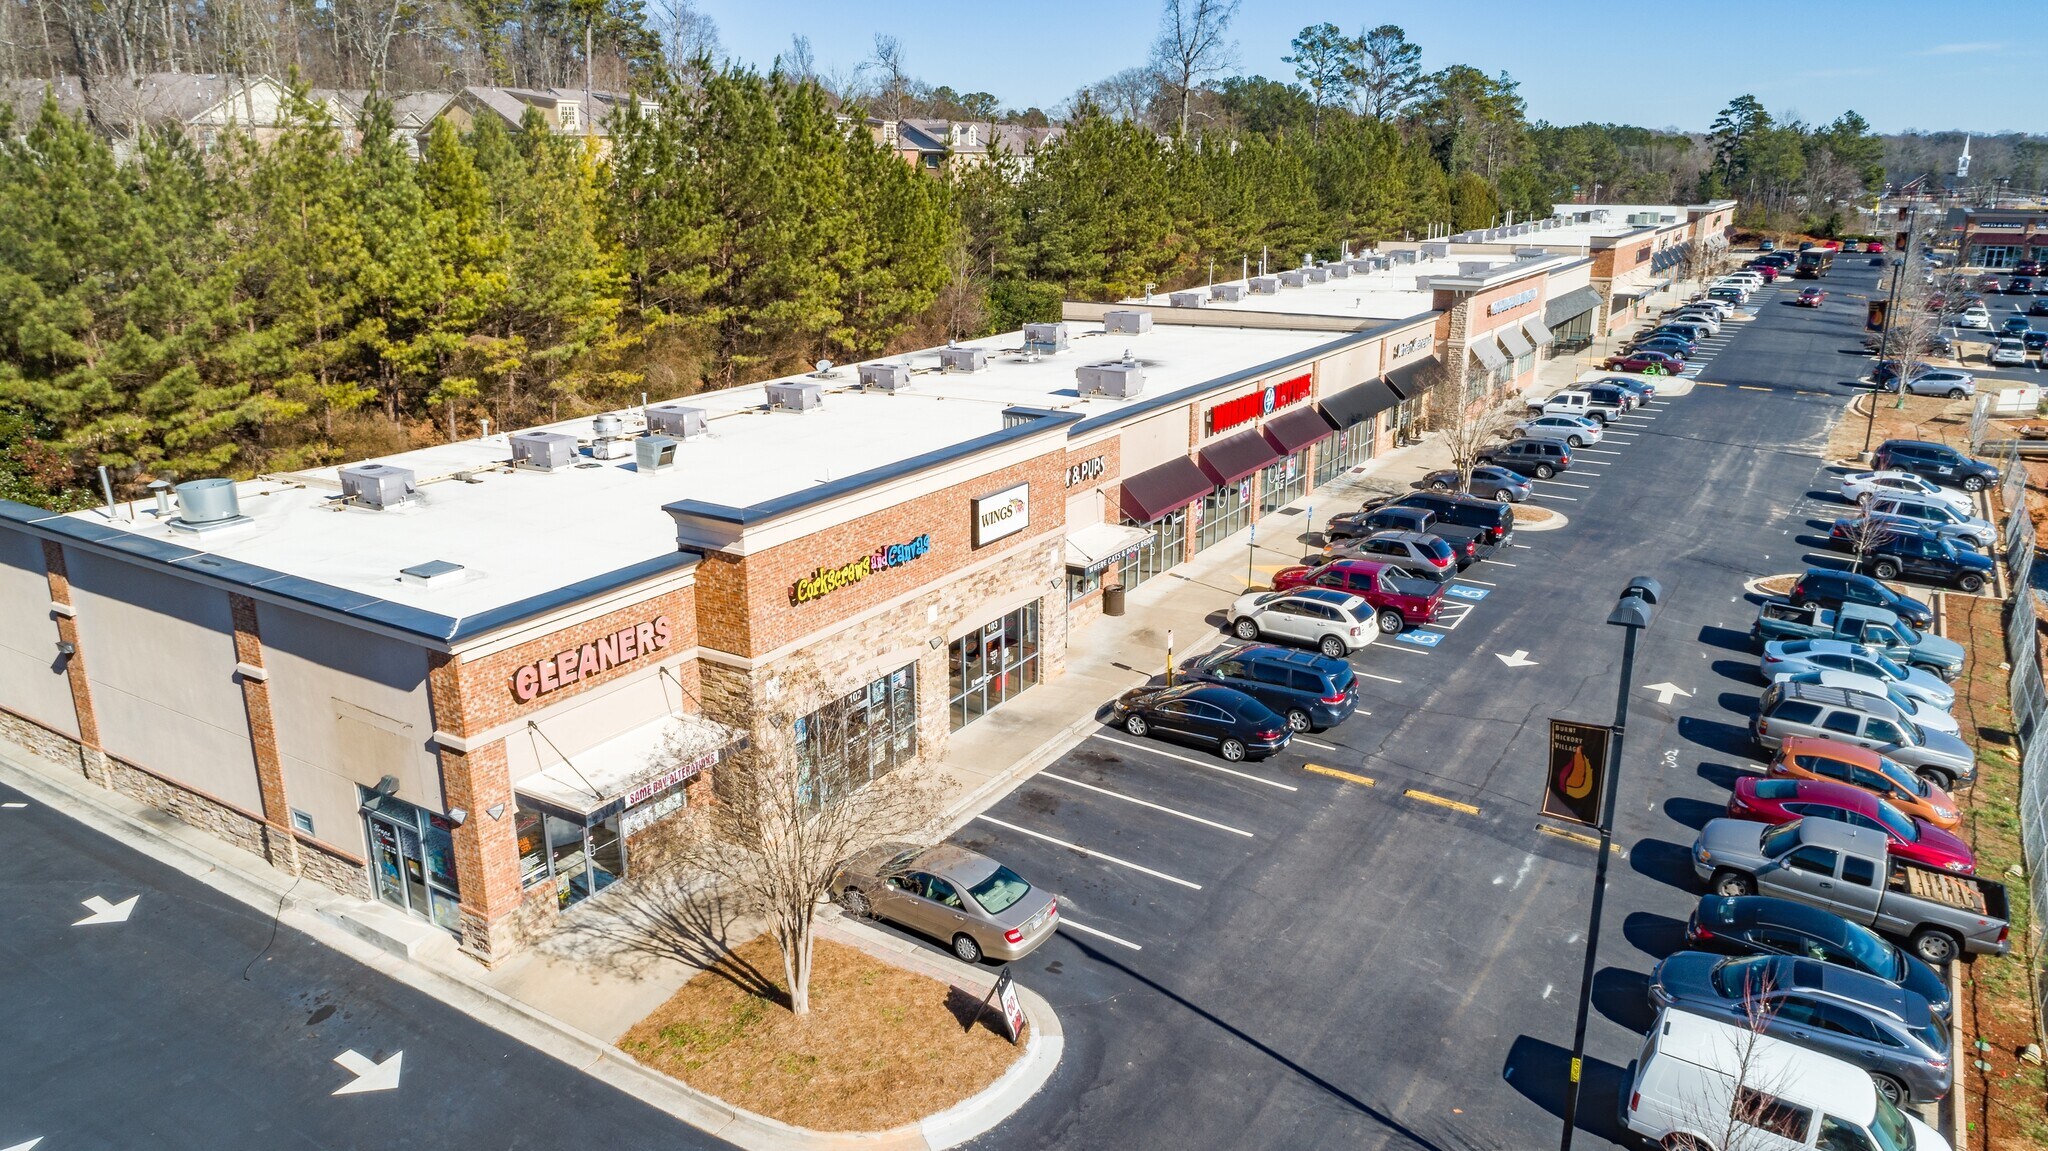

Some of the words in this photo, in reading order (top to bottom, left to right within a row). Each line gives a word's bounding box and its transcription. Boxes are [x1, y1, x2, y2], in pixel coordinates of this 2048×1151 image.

[1073, 466, 1080, 484] &
[1081, 456, 1105, 480] PUPS
[981, 504, 1013, 527] WINGS
[797, 555, 870, 601] Corkscrews
[871, 546, 888, 569] and
[888, 534, 930, 566] Canvas
[1089, 560, 1107, 573] WHERE
[1108, 553, 1121, 565] CATS
[1126, 543, 1140, 555] DOGS
[987, 620, 999, 633] 103
[513, 615, 673, 702] CLEANERS
[1555, 733, 1583, 744] HICKORY
[1555, 742, 1580, 752] VILLAG
[630, 785, 651, 804] SAME
[653, 777, 667, 793] DAY
